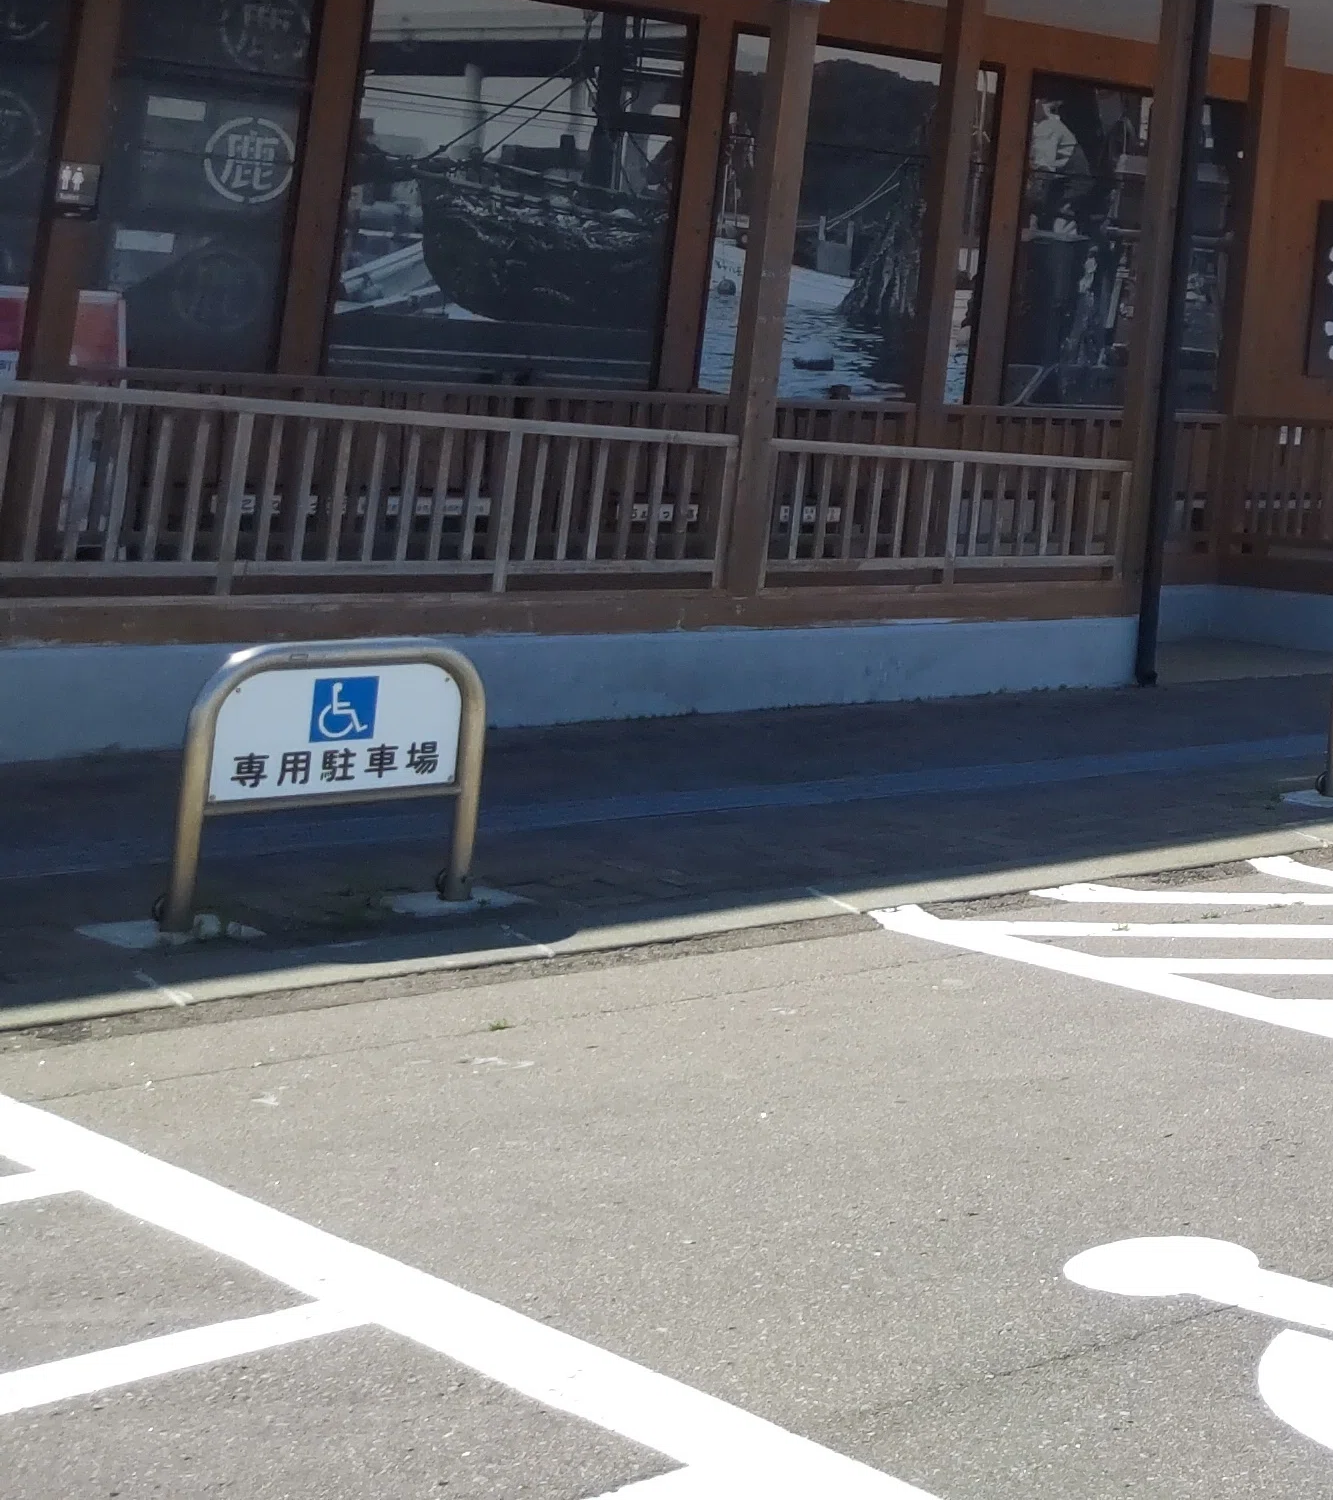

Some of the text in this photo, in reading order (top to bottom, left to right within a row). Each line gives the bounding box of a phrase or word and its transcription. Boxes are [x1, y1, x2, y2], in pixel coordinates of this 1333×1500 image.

[230, 740, 440, 788] 専用駐車場
